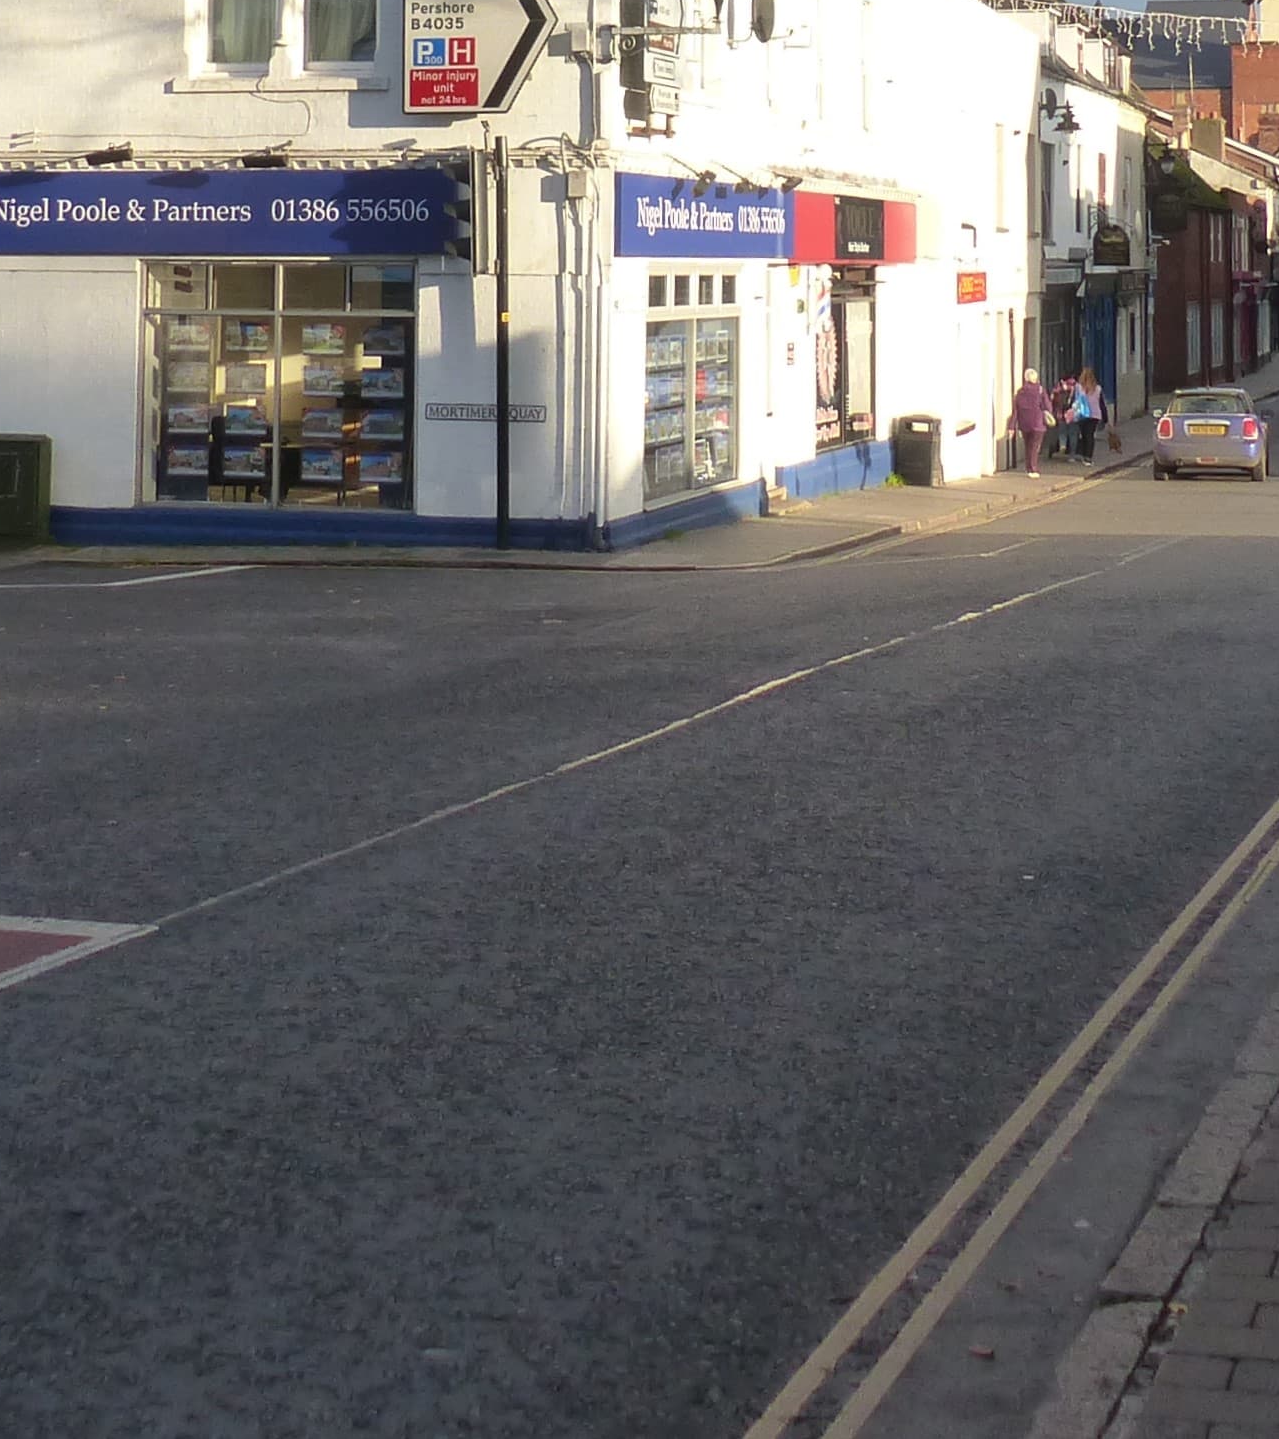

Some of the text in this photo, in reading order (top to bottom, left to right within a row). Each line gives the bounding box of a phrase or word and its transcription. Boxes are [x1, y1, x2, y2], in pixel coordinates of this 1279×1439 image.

[411, 2, 475, 15] Pershore
[411, 17, 464, 30] B4035
[417, 40, 434, 64] P
[453, 40, 471, 63] H
[412, 70, 476, 82] Minor injury
[433, 83, 455, 93] unit
[421, 96, 436, 104] not
[57, 198, 121, 222] Poole
[126, 198, 146, 222] &
[153, 198, 252, 222] Partners
[271, 198, 340, 222] 01386
[345, 198, 430, 222] 556506
[636, 196, 663, 236] Nigel
[664, 198, 689, 229] Poole
[690, 201, 699, 230] &
[699, 202, 734, 232] Partners
[738, 205, 760, 233] 01386
[428, 406, 542, 419] MORTIMER QUAY
